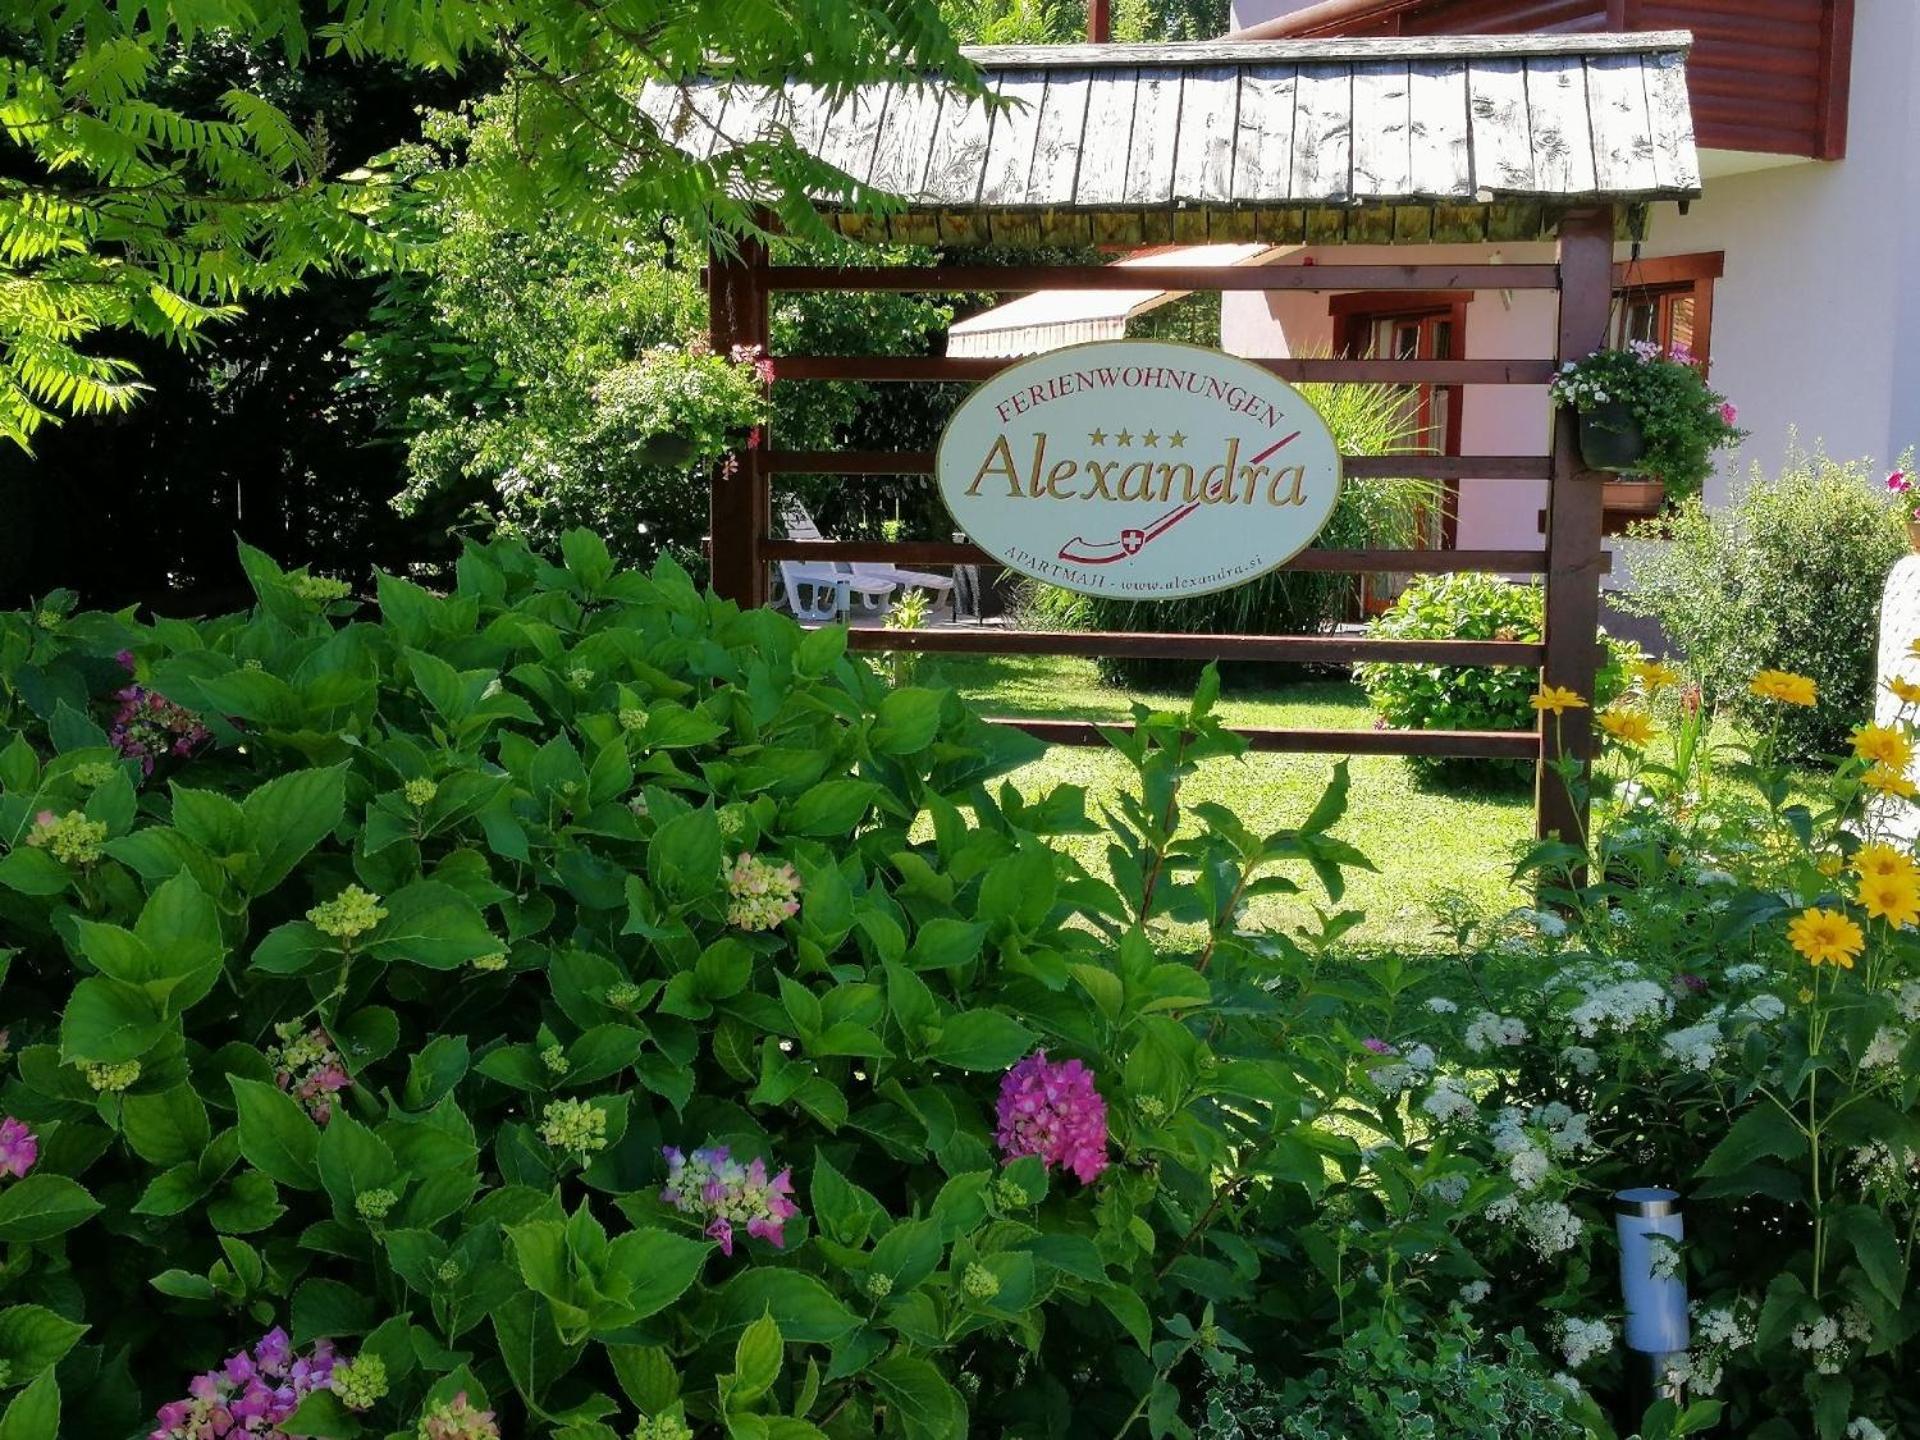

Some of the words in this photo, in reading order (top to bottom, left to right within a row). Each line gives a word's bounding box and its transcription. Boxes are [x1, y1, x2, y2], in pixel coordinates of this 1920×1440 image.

[995, 366, 1285, 429] FERIENWOHNUNGEN
[964, 432, 1308, 507] Alexandra
[1004, 546, 1106, 589] APARTMAJI
[1120, 554, 1264, 591] www.alexandra.si
